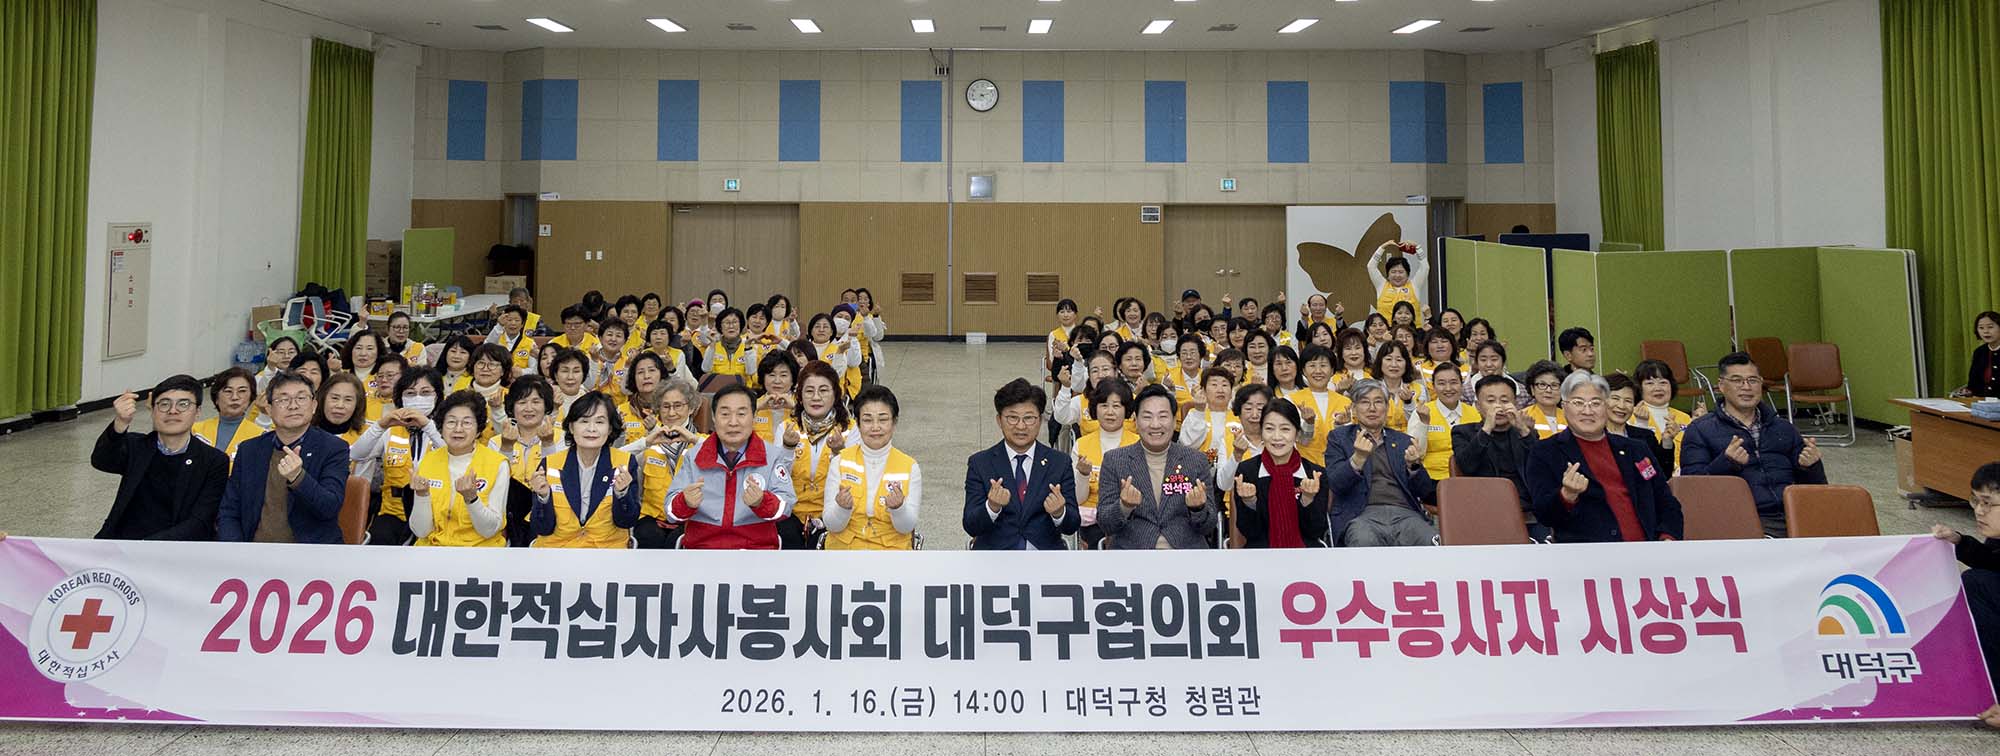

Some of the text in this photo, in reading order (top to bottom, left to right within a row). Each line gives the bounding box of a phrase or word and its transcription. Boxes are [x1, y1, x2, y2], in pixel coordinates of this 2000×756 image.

[1162, 482, 1193, 495] 전석광
[48, 572, 140, 606] KOREAN RED CROSS
[200, 575, 1748, 661] 2026 대한적십자사봉사회 대덕구협의회 우수봉사자 시상식
[38, 649, 120, 679] 대한적십자사
[1821, 652, 1917, 680] 대덕구
[721, 688, 794, 716] 2026.
[813, 689, 832, 716] 1.
[850, 686, 936, 718] 16.(금)
[953, 689, 1025, 714] 14:00
[1066, 686, 1167, 717] 대덕구청
[1185, 685, 1261, 717] 청렴관
